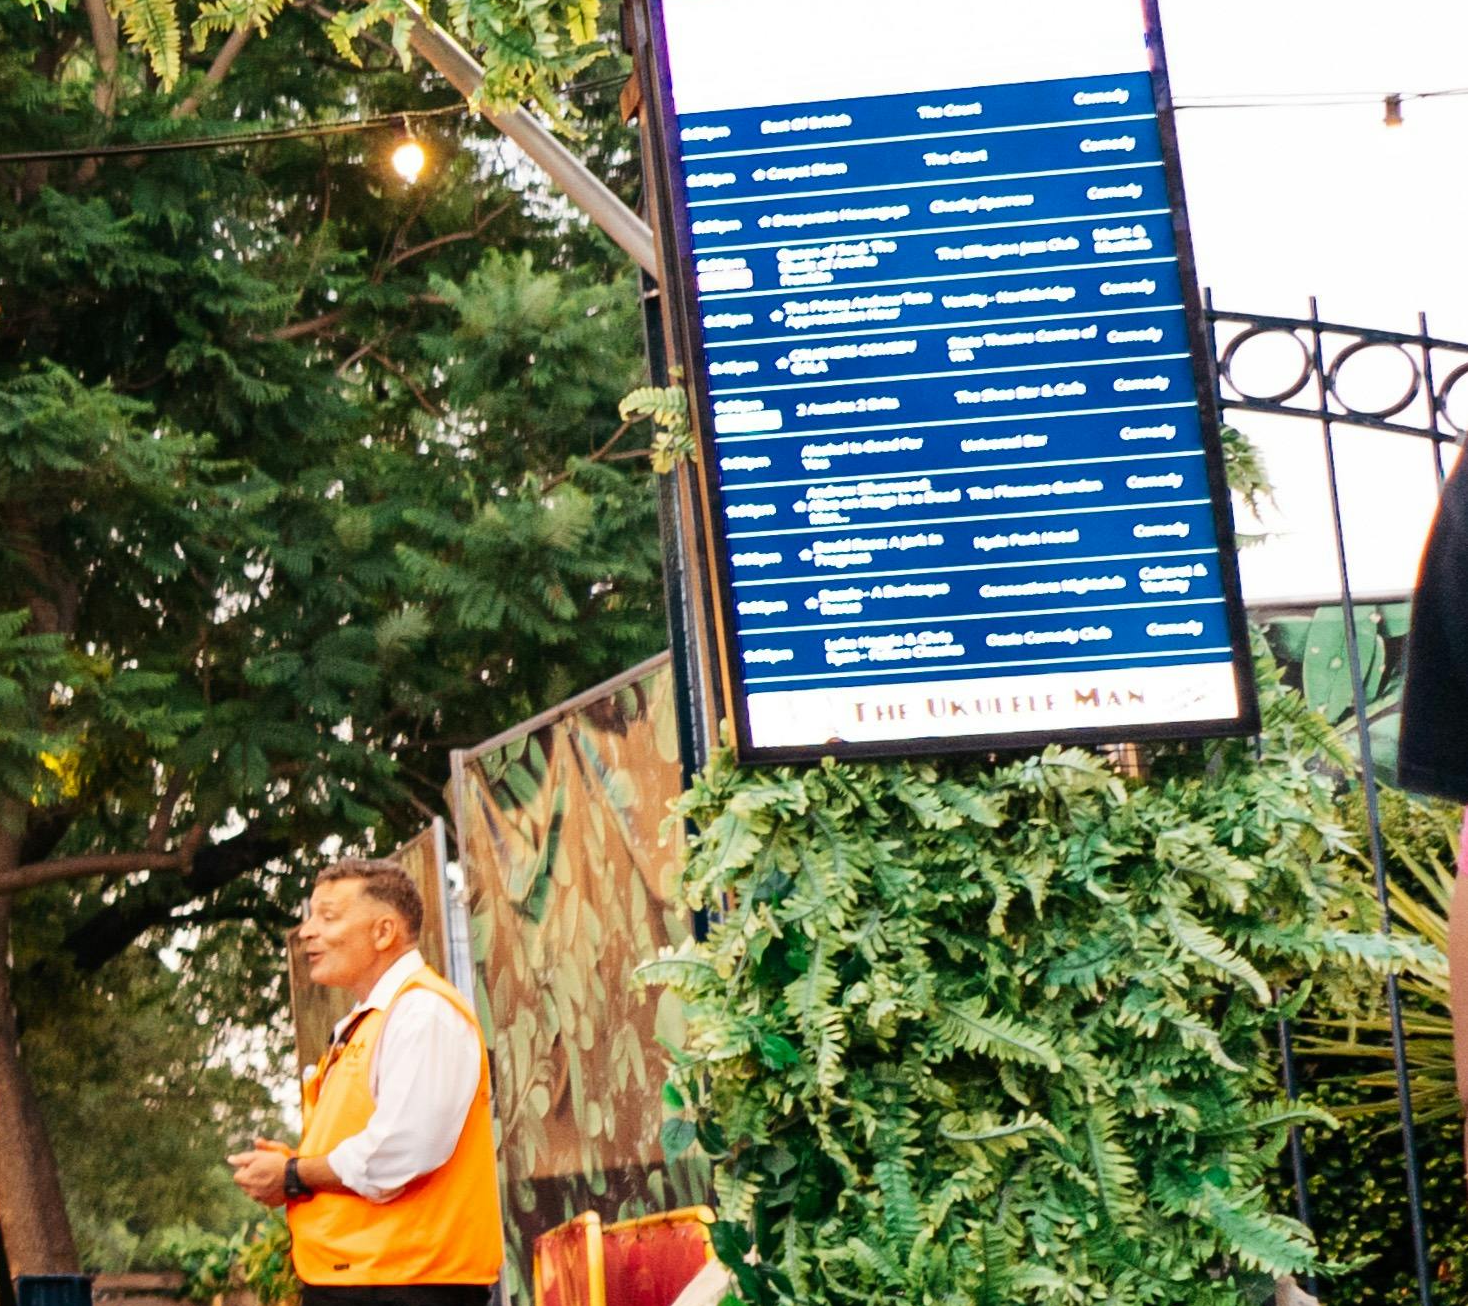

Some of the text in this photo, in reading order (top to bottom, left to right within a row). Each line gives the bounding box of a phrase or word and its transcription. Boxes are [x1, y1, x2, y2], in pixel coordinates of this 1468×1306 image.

[1074, 89, 1128, 104] Comedy
[917, 107, 943, 117] The
[1081, 136, 1134, 151] Comedy
[923, 153, 949, 164] The
[1087, 184, 1141, 199] Comedy
[869, 240, 895, 252] The
[935, 247, 962, 259] The
[1100, 279, 1155, 294] Comedy
[782, 302, 809, 314] The
[1107, 327, 1161, 342] Comedy
[1113, 376, 1168, 391] Comedy
[954, 390, 980, 402] The
[1120, 424, 1175, 439] Comedy
[1127, 473, 1182, 487] Comedy
[966, 487, 993, 499] The
[1133, 522, 1188, 537] Comedy
[1146, 621, 1202, 635] Comedy
[1023, 629, 1078, 643] Comedy
